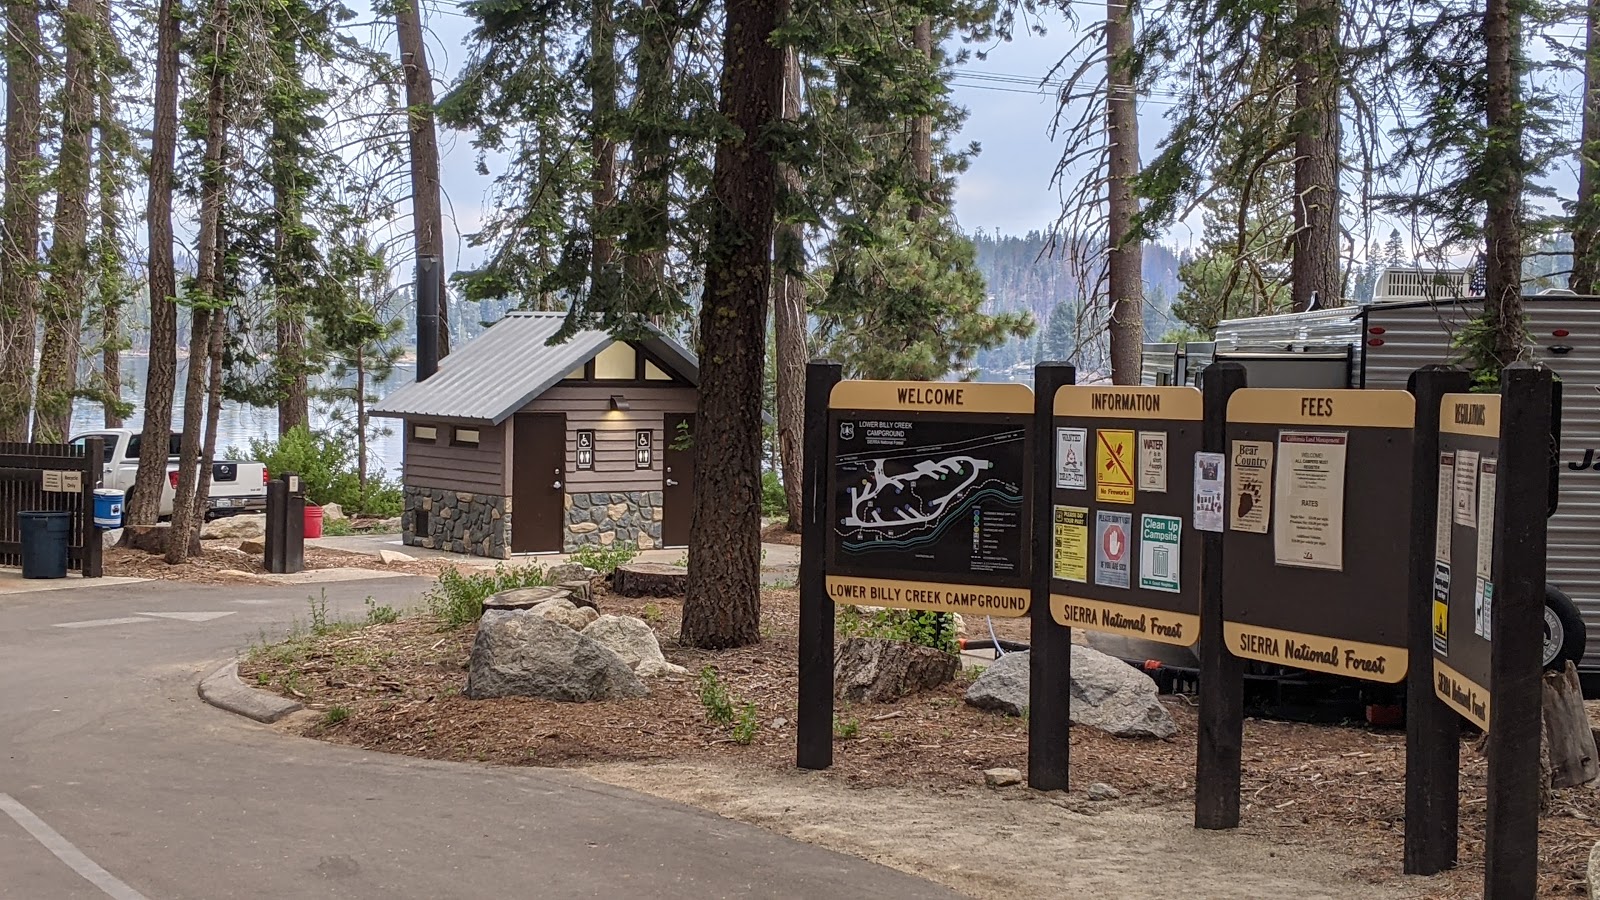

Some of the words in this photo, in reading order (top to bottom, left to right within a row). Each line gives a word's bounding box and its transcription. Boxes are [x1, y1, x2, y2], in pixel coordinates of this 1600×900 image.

[897, 387, 964, 405] WELCOME
[1091, 393, 1160, 412] INFORMATION
[1300, 397, 1333, 417] FEES
[1454, 403, 1486, 426] REGULATIONS
[879, 421, 894, 429] BILLY
[866, 429, 905, 437] CAMPGROUND
[1143, 439, 1164, 450] WATER
[1239, 444, 1259, 456] Bear
[1234, 454, 1268, 469] Country
[1107, 488, 1130, 496] Fireworks
[1301, 499, 1319, 507] RATES
[1144, 518, 1166, 530] Clean
[1168, 520, 1179, 533] Up
[1144, 529, 1178, 541] Campsite
[1104, 561, 1112, 569] YOU
[1111, 562, 1119, 570] ARE
[829, 583, 867, 600] LOWER
[869, 586, 901, 602] BILLY
[905, 588, 942, 606] CREEK
[945, 591, 1026, 610] CAMPGROUND
[1063, 604, 1098, 625] SIERRA
[1101, 607, 1147, 633] National
[1150, 616, 1183, 639] Forest
[1239, 632, 1279, 658] SIERRA
[1284, 637, 1339, 667] National
[1344, 648, 1386, 675] Forest
